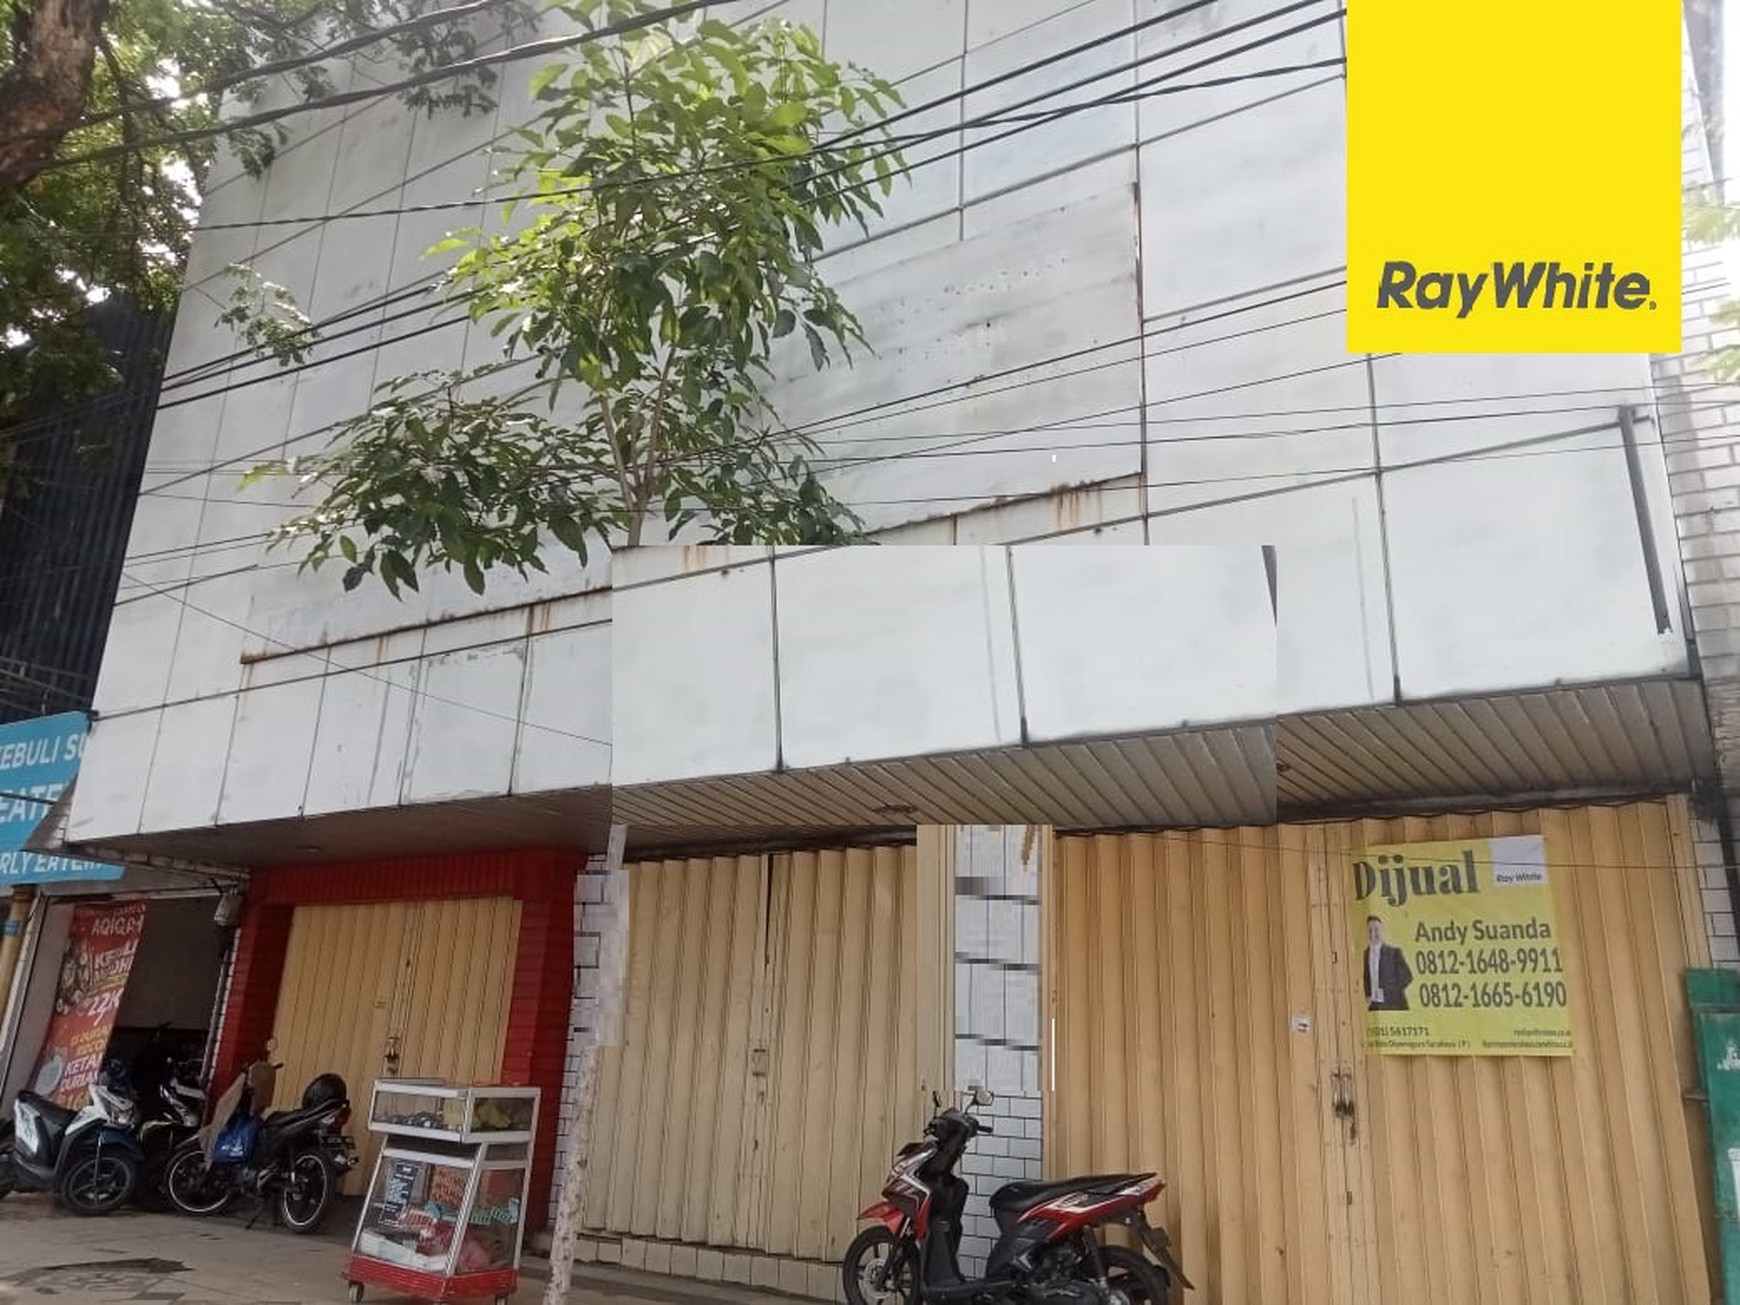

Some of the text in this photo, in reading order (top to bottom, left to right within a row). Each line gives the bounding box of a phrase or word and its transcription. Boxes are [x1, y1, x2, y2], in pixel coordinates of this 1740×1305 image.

[1353, 850, 1480, 907] Dijual
[1415, 917, 1551, 945] Andy Suanda
[1416, 947, 1564, 975] 0812-1648-9911
[1419, 981, 1567, 1008] 0812-1665-6190
